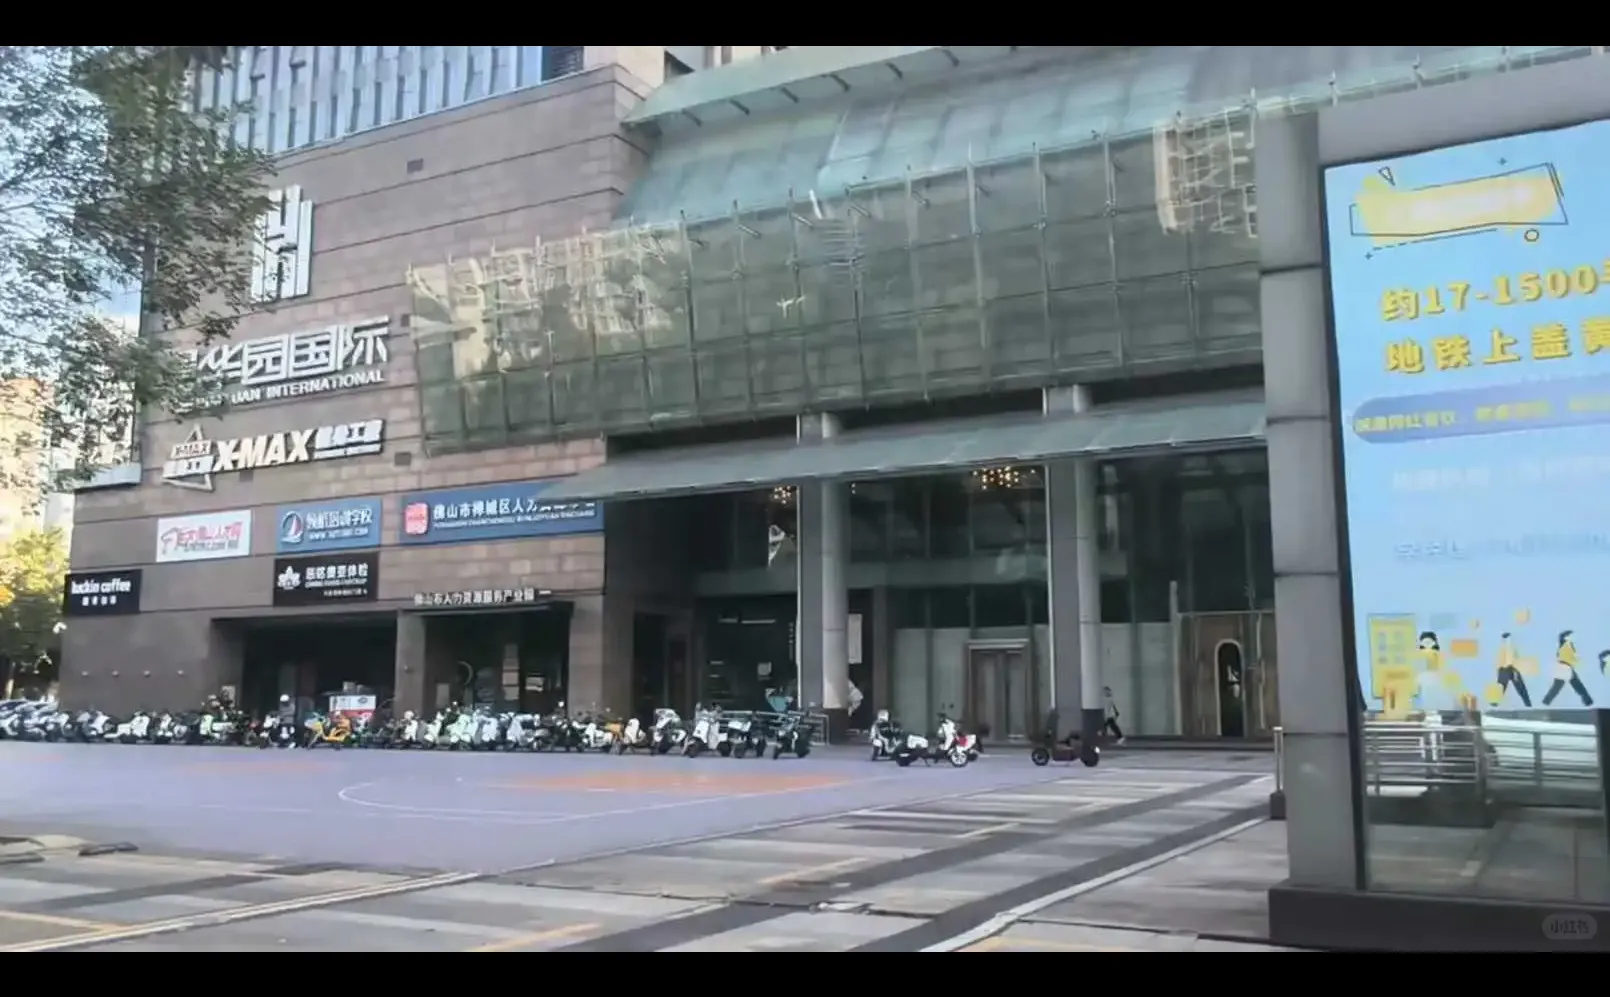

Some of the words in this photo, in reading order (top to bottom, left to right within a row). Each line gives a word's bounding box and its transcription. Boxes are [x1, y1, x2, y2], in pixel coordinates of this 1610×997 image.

[266, 369, 386, 399] INTERNATIONAL
[212, 429, 314, 471] X-MAX
[101, 578, 131, 593] coffee
